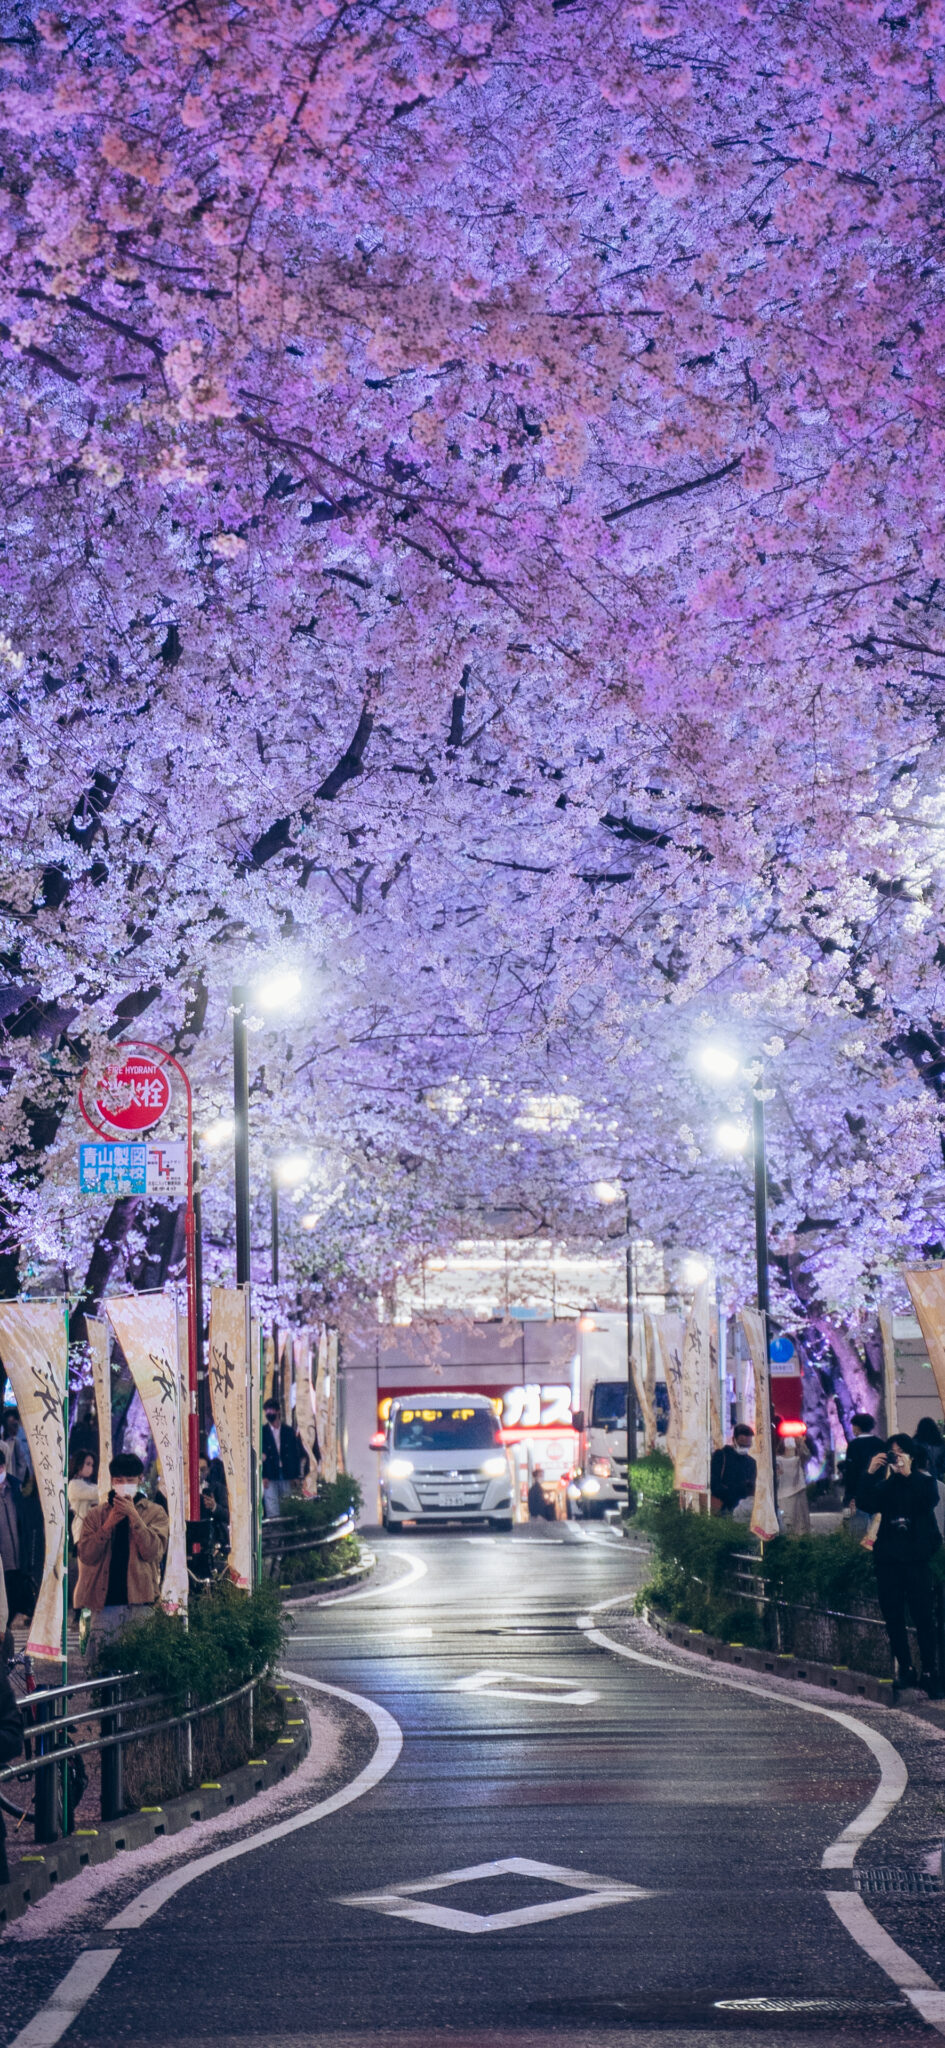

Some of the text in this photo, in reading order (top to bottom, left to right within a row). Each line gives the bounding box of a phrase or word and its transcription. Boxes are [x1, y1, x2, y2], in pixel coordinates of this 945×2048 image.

[108, 1066, 157, 1074] FIRE HYDRANT
[82, 1146, 145, 1167] 青山製図
